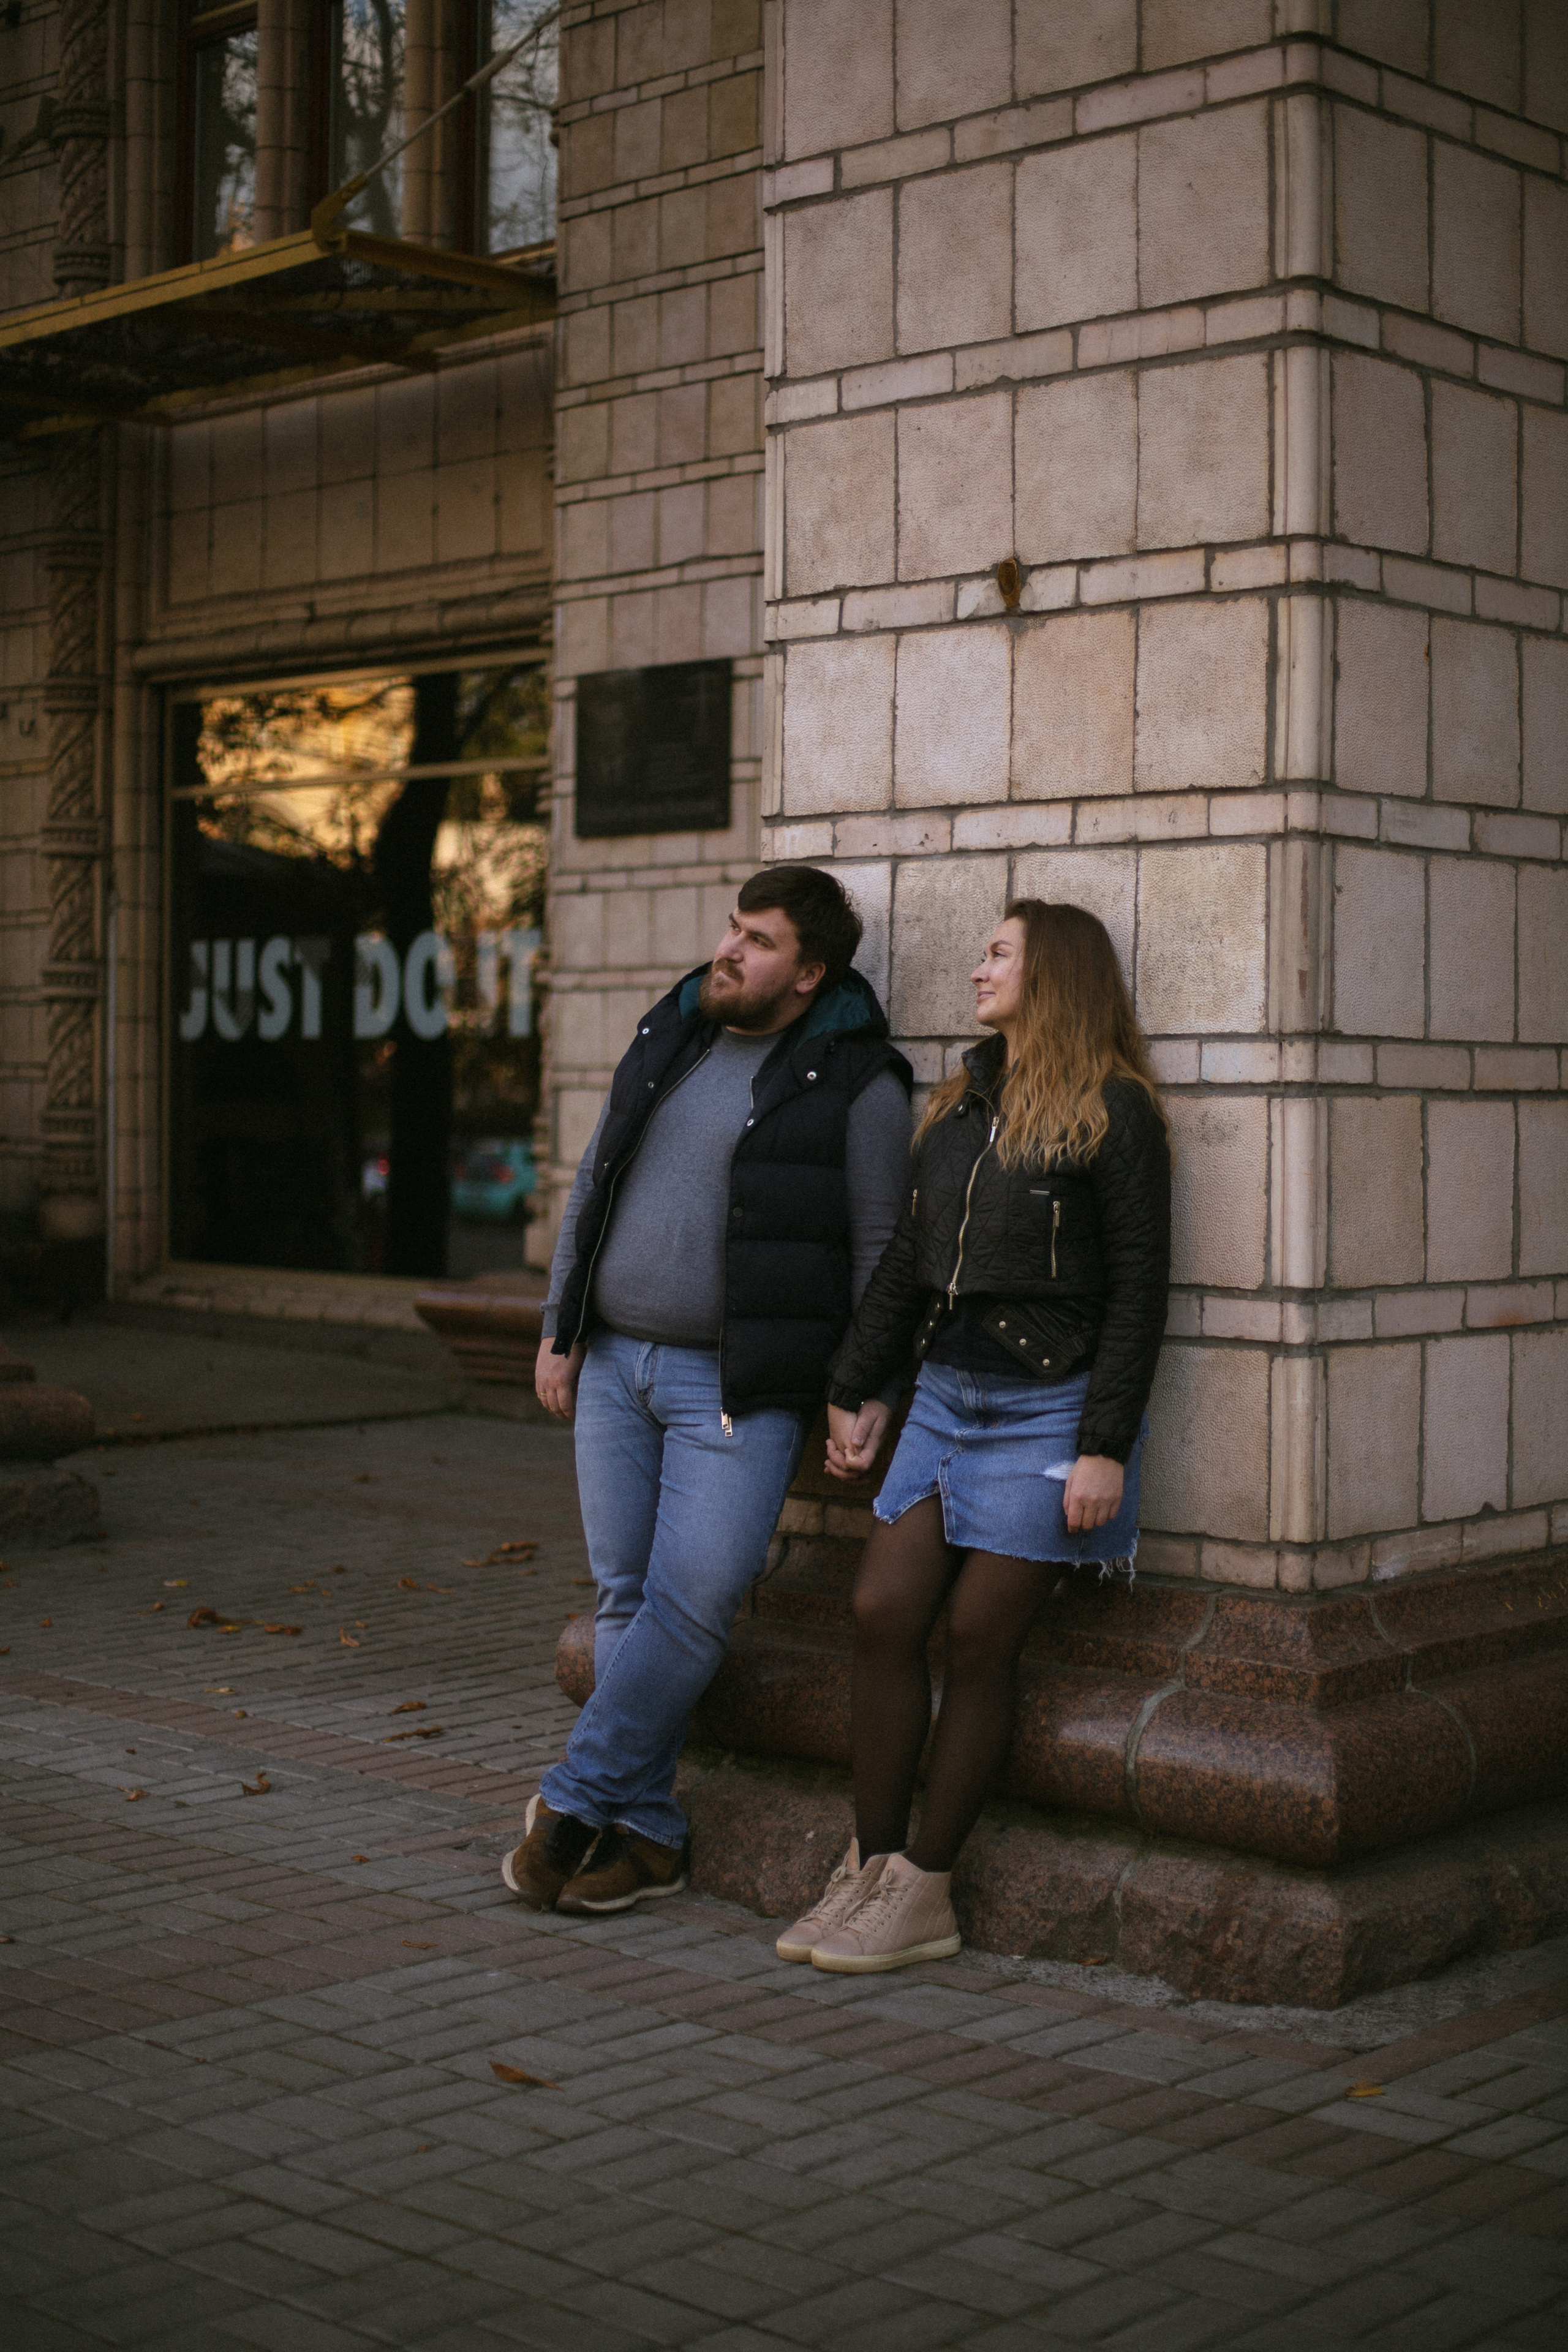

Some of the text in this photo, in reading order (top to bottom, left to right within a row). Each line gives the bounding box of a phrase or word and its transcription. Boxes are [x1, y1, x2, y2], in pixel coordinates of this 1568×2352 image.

[180, 928, 542, 1041] JUST DO IT
